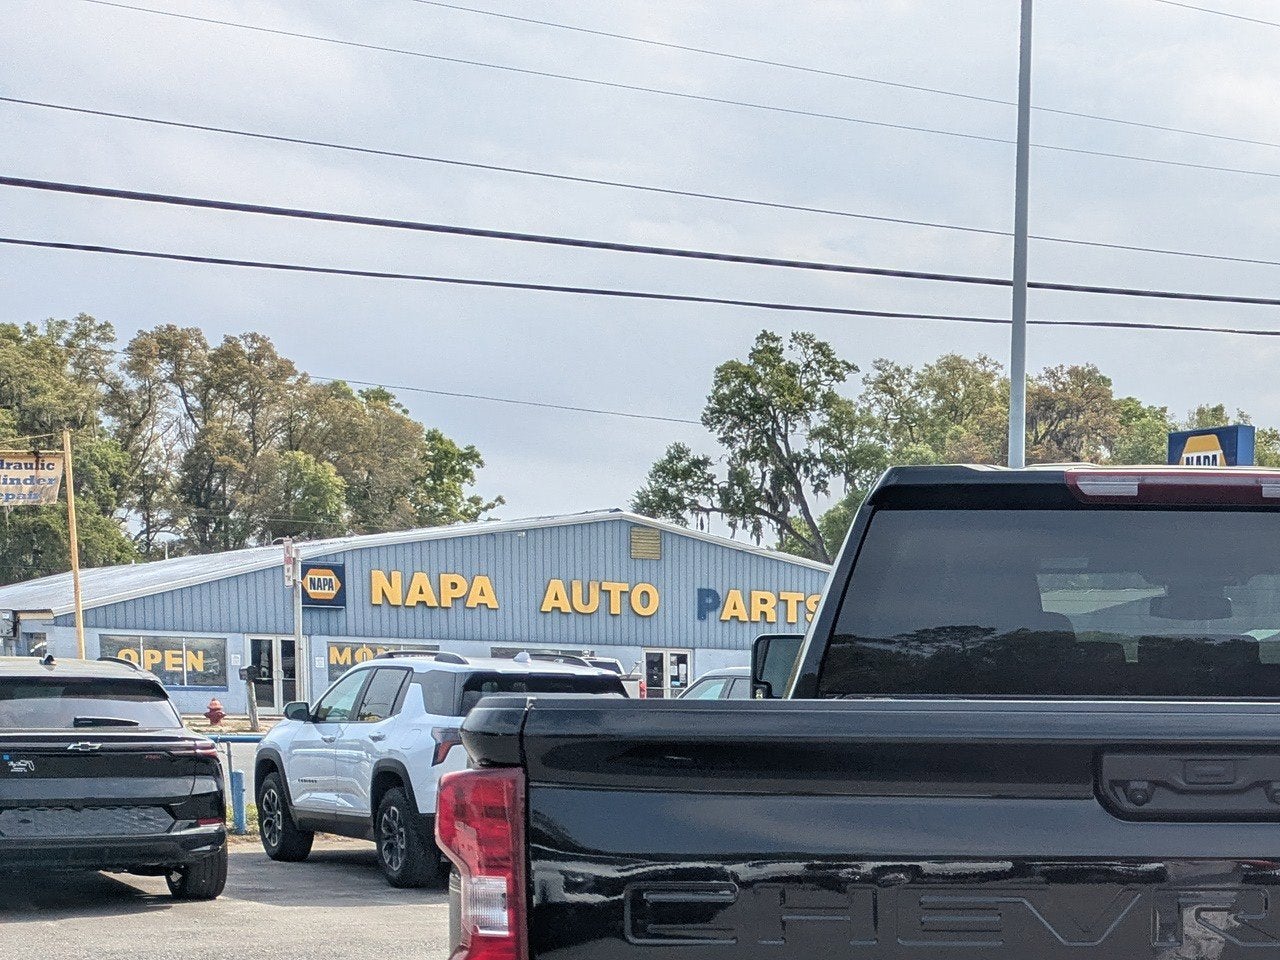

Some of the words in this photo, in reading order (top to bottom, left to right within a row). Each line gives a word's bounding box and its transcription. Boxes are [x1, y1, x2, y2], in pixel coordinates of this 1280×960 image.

[0, 474, 56, 486] inder
[309, 577, 334, 591] NAPA
[371, 569, 499, 610] NAPA
[540, 579, 660, 617] AUTO
[117, 647, 204, 672] OPEN
[329, 645, 387, 665] MO
